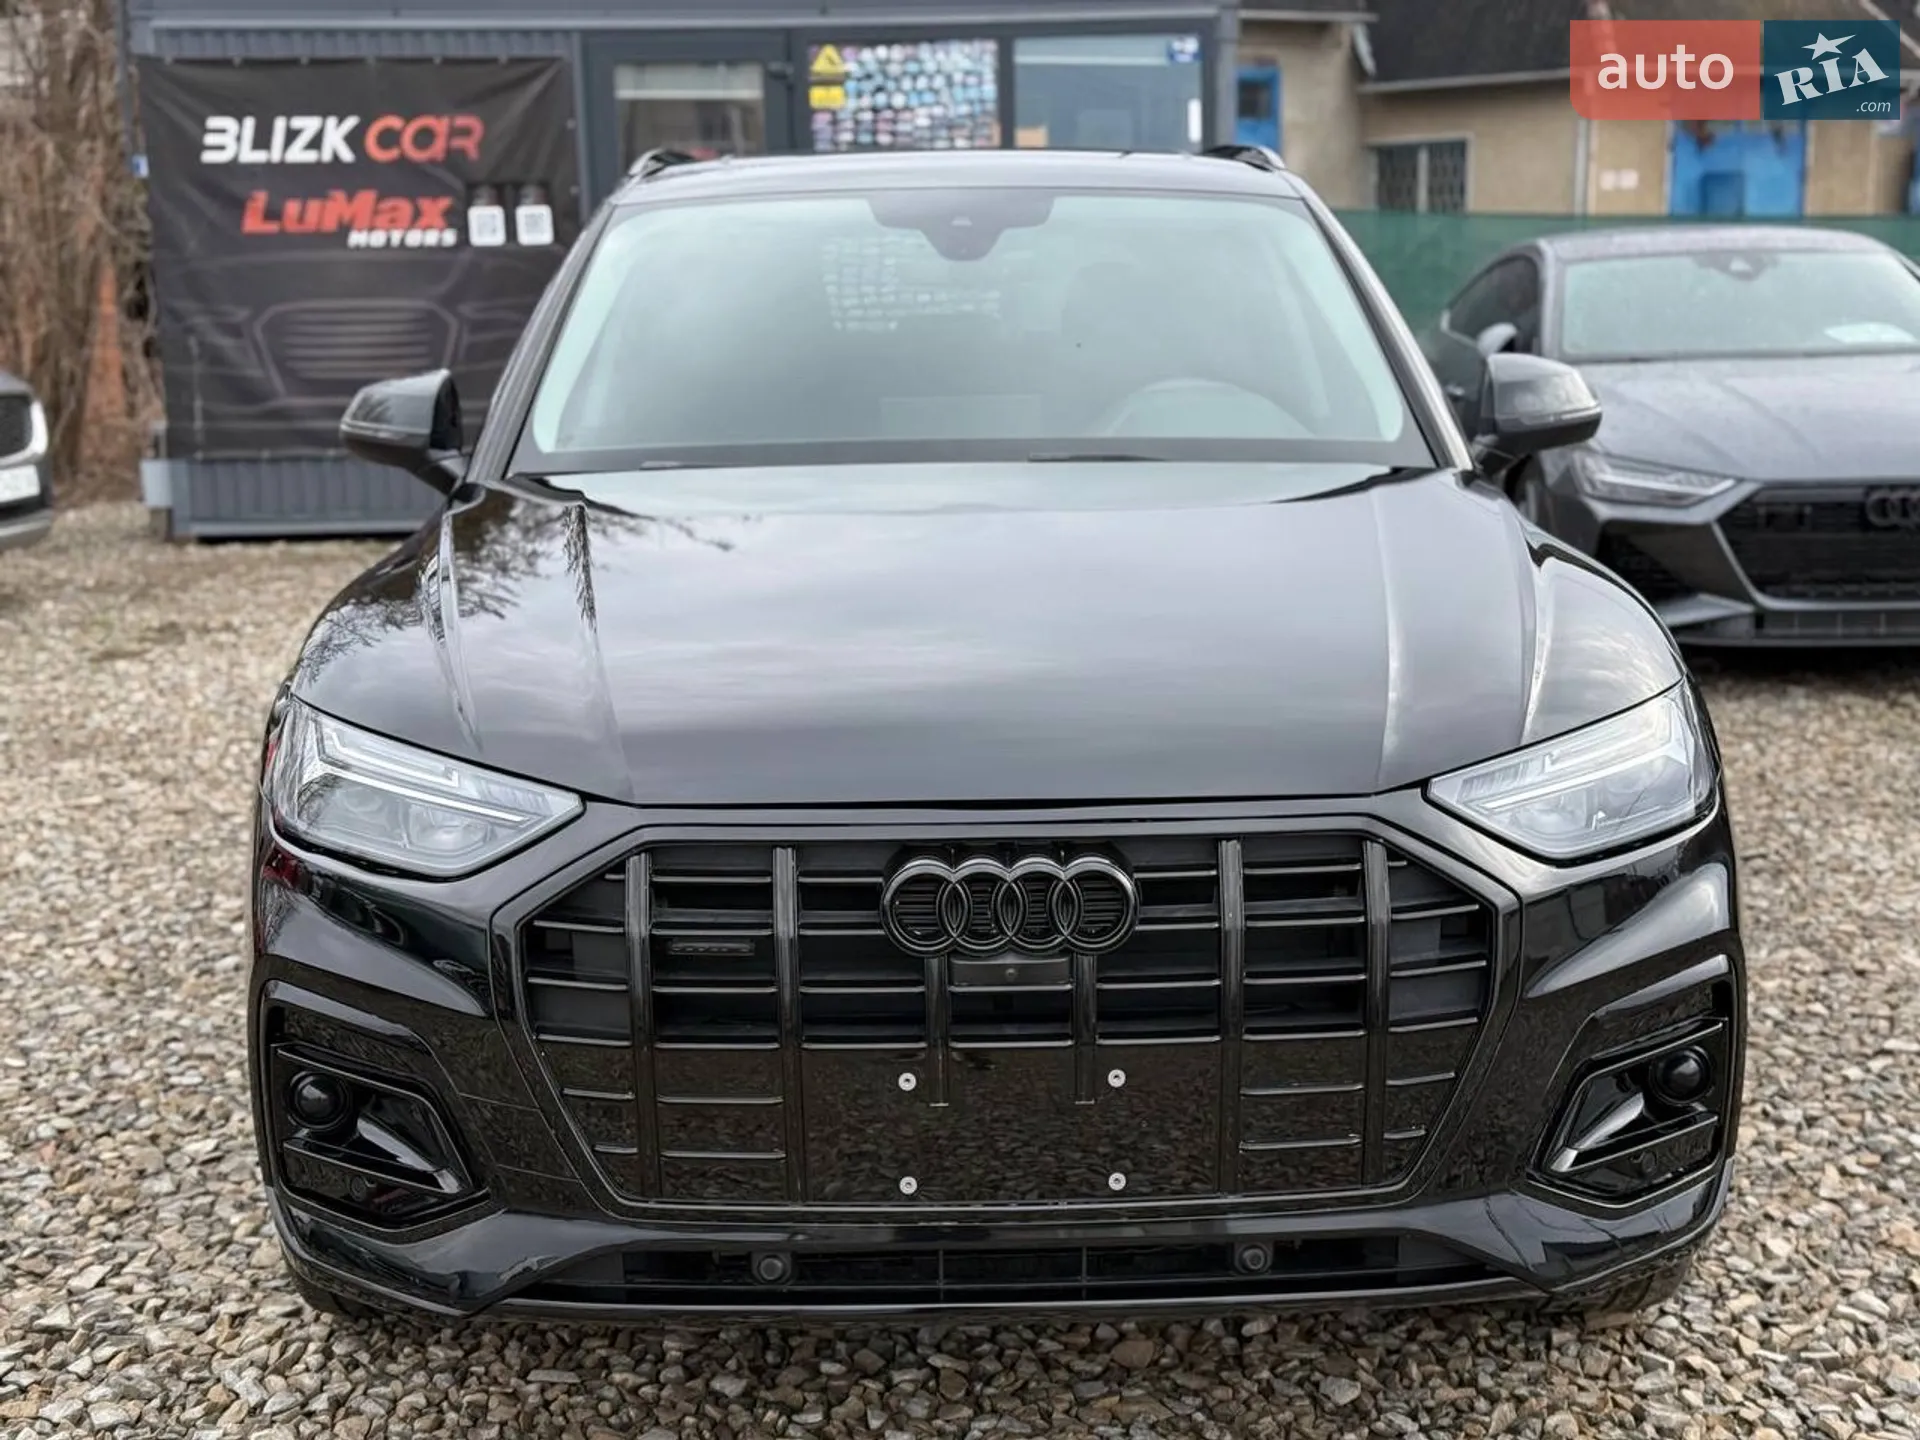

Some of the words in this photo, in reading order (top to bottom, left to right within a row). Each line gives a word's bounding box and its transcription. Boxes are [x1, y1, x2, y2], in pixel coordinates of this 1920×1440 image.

[200, 115, 361, 164] BLIZK
[241, 189, 454, 235] LuMax
[347, 228, 458, 249] MOTORS
